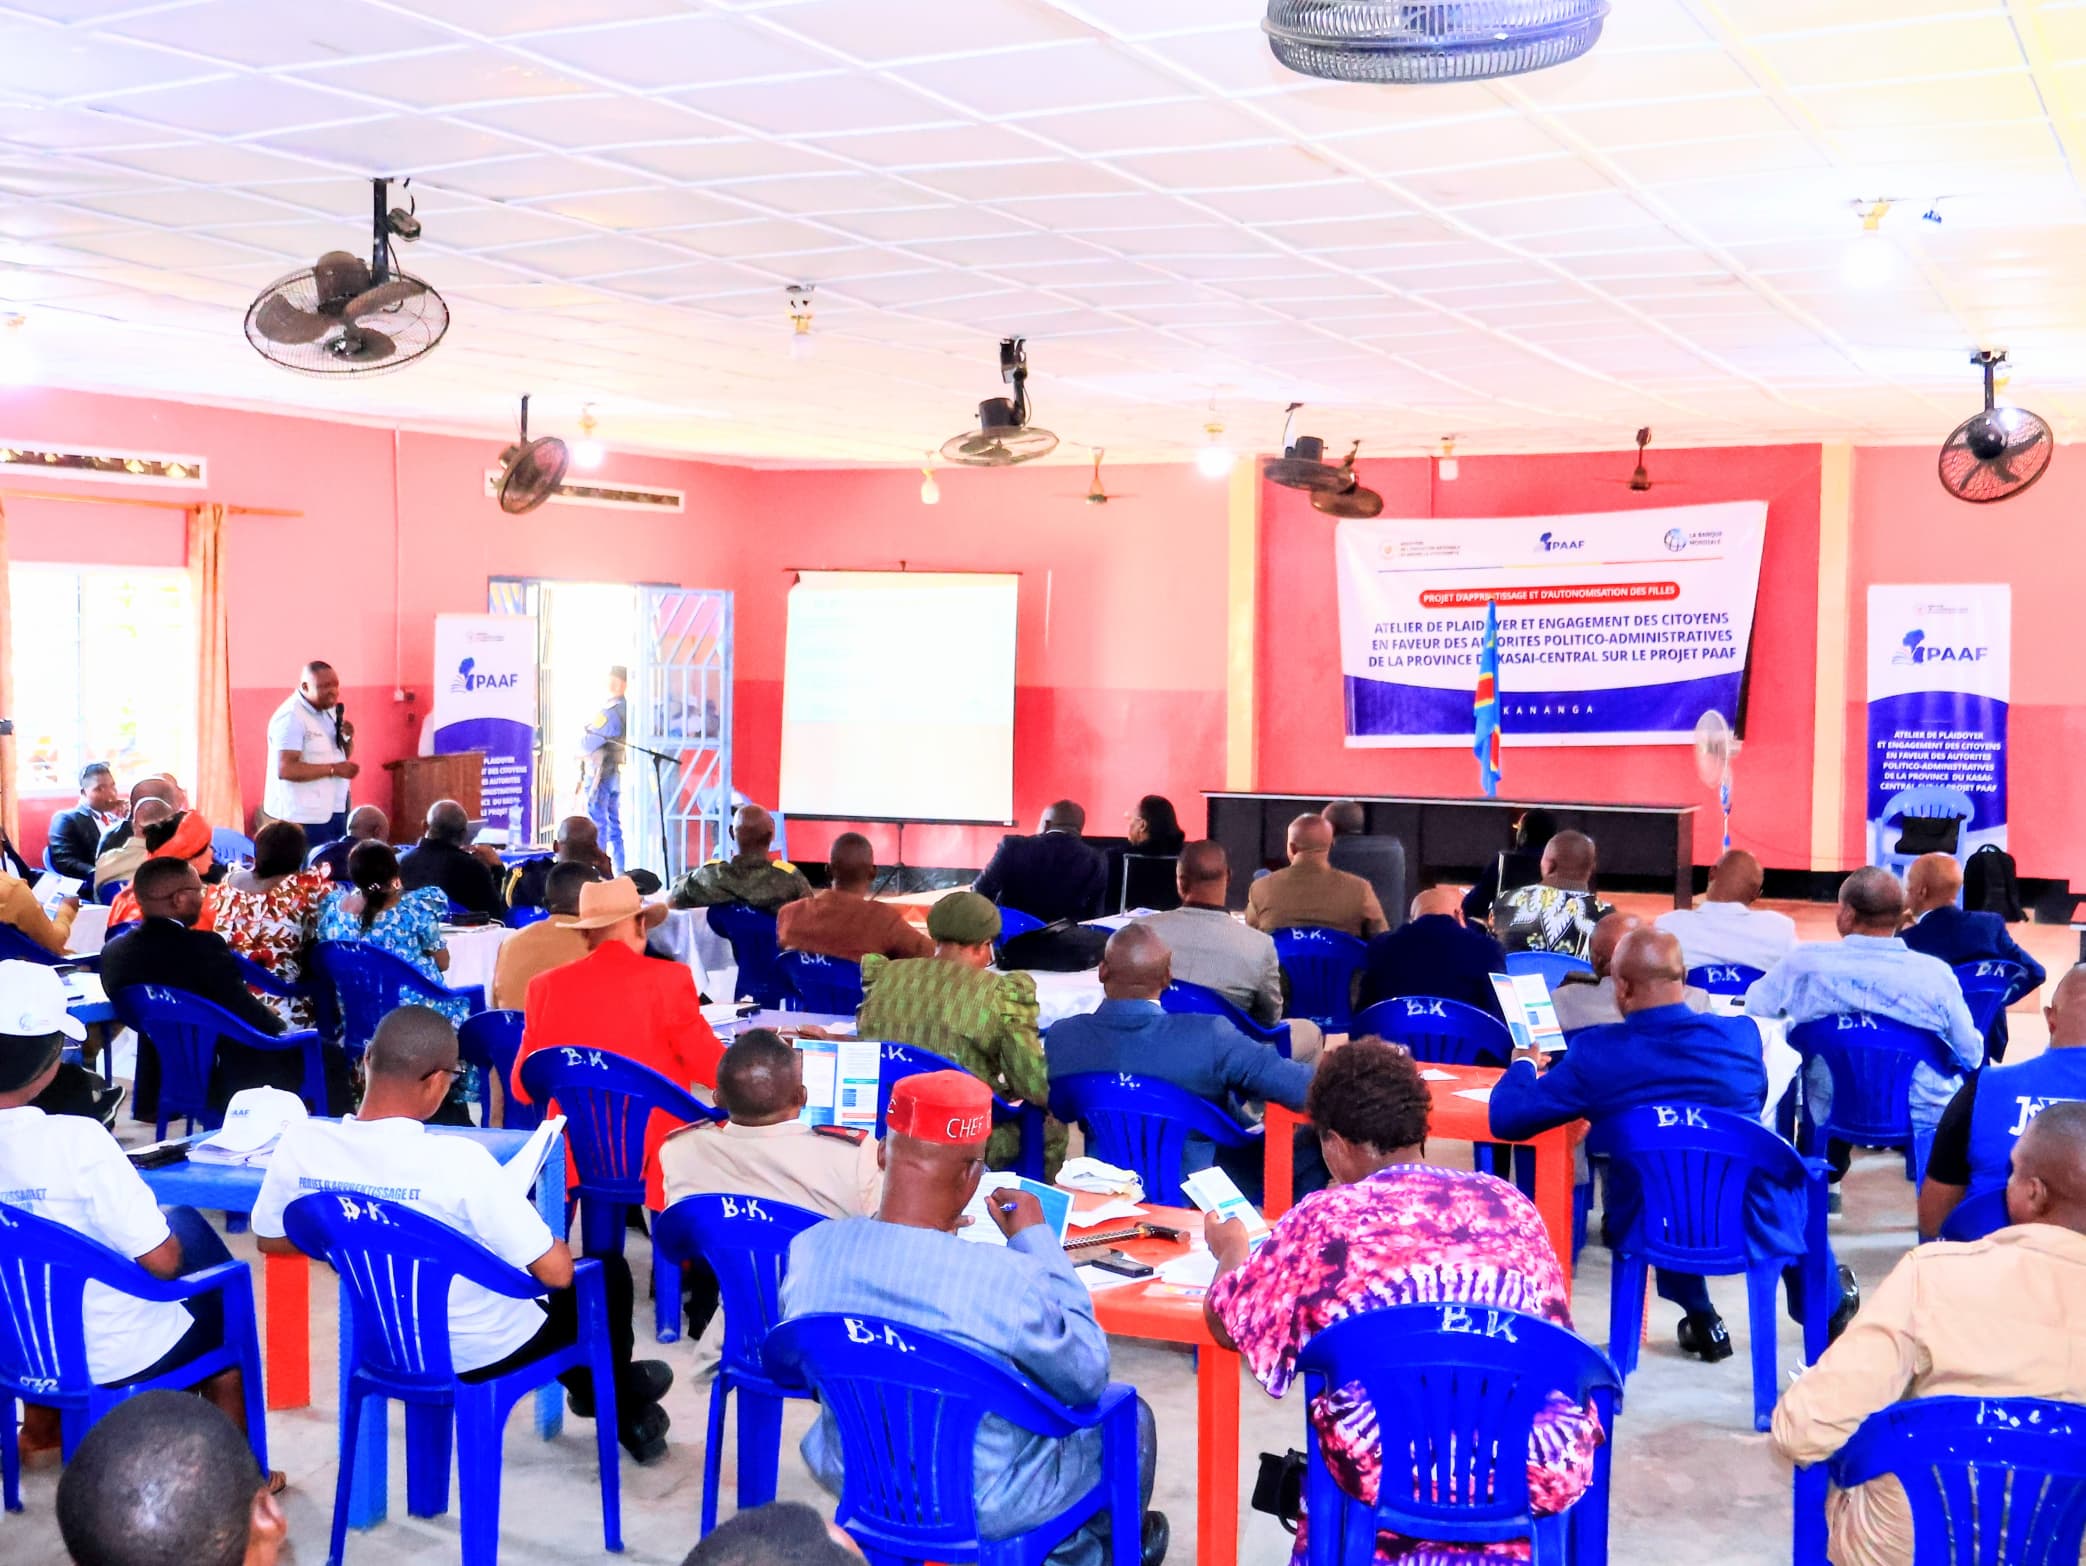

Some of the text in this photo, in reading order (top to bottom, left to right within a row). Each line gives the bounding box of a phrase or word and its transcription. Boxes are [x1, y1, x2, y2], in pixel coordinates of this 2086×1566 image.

[1552, 540, 1585, 549] PAAF
[1424, 593, 1454, 604] PROJET
[1529, 590, 1538, 599] ET
[1540, 587, 1628, 599] D'AUTONOMISATION
[1630, 586, 1646, 596] DES
[1648, 585, 1675, 595] FILLES
[1375, 612, 1729, 634] ATELIER DE PLAIDYER ET ENGAGEMENT DES CITOYENS
[1372, 639, 1388, 651] EN
[1392, 637, 1440, 650] FAVEUR
[1444, 637, 1468, 649] DES
[1544, 630, 1733, 646] POLITICO-ADMINISTRATIVES
[1369, 656, 1385, 667] DE
[1388, 655, 1404, 666] LA
[1407, 654, 1472, 666] PROVINCE
[1498, 651, 1599, 665] KASAI-CENTRAL
[1602, 650, 1628, 662] SUR
[1632, 650, 1647, 661] LE
[1650, 648, 1698, 663] PROJET
[1702, 647, 1737, 659] PAAF
[1927, 647, 1988, 661] PAAF
[476, 673, 518, 689] PAAF
[1503, 704, 1593, 715] KANANGA
[1893, 731, 1984, 740] ATELIER DE PLAIDOYER
[1877, 741, 2001, 751] ET ENGAGEMENT DES CITOYENS
[1886, 752, 1992, 761] EN FAVEUR DES AUTORITES
[1883, 762, 1995, 772] POLITICO-ADMINISTRATIVES
[1884, 772, 1895, 780] DE
[1896, 772, 1907, 780] LA
[1908, 772, 1949, 781] PROVINCE
[1952, 772, 1965, 781] DU
[1976, 784, 1998, 793] PAAF
[1405, 998, 1447, 1018] B.K
[560, 1047, 609, 1070] B.K
[1652, 1105, 1708, 1129] B.K
[409, 1188, 421, 1201] ET
[721, 1196, 774, 1222] B.K.
[1441, 1306, 1519, 1343] B.K
